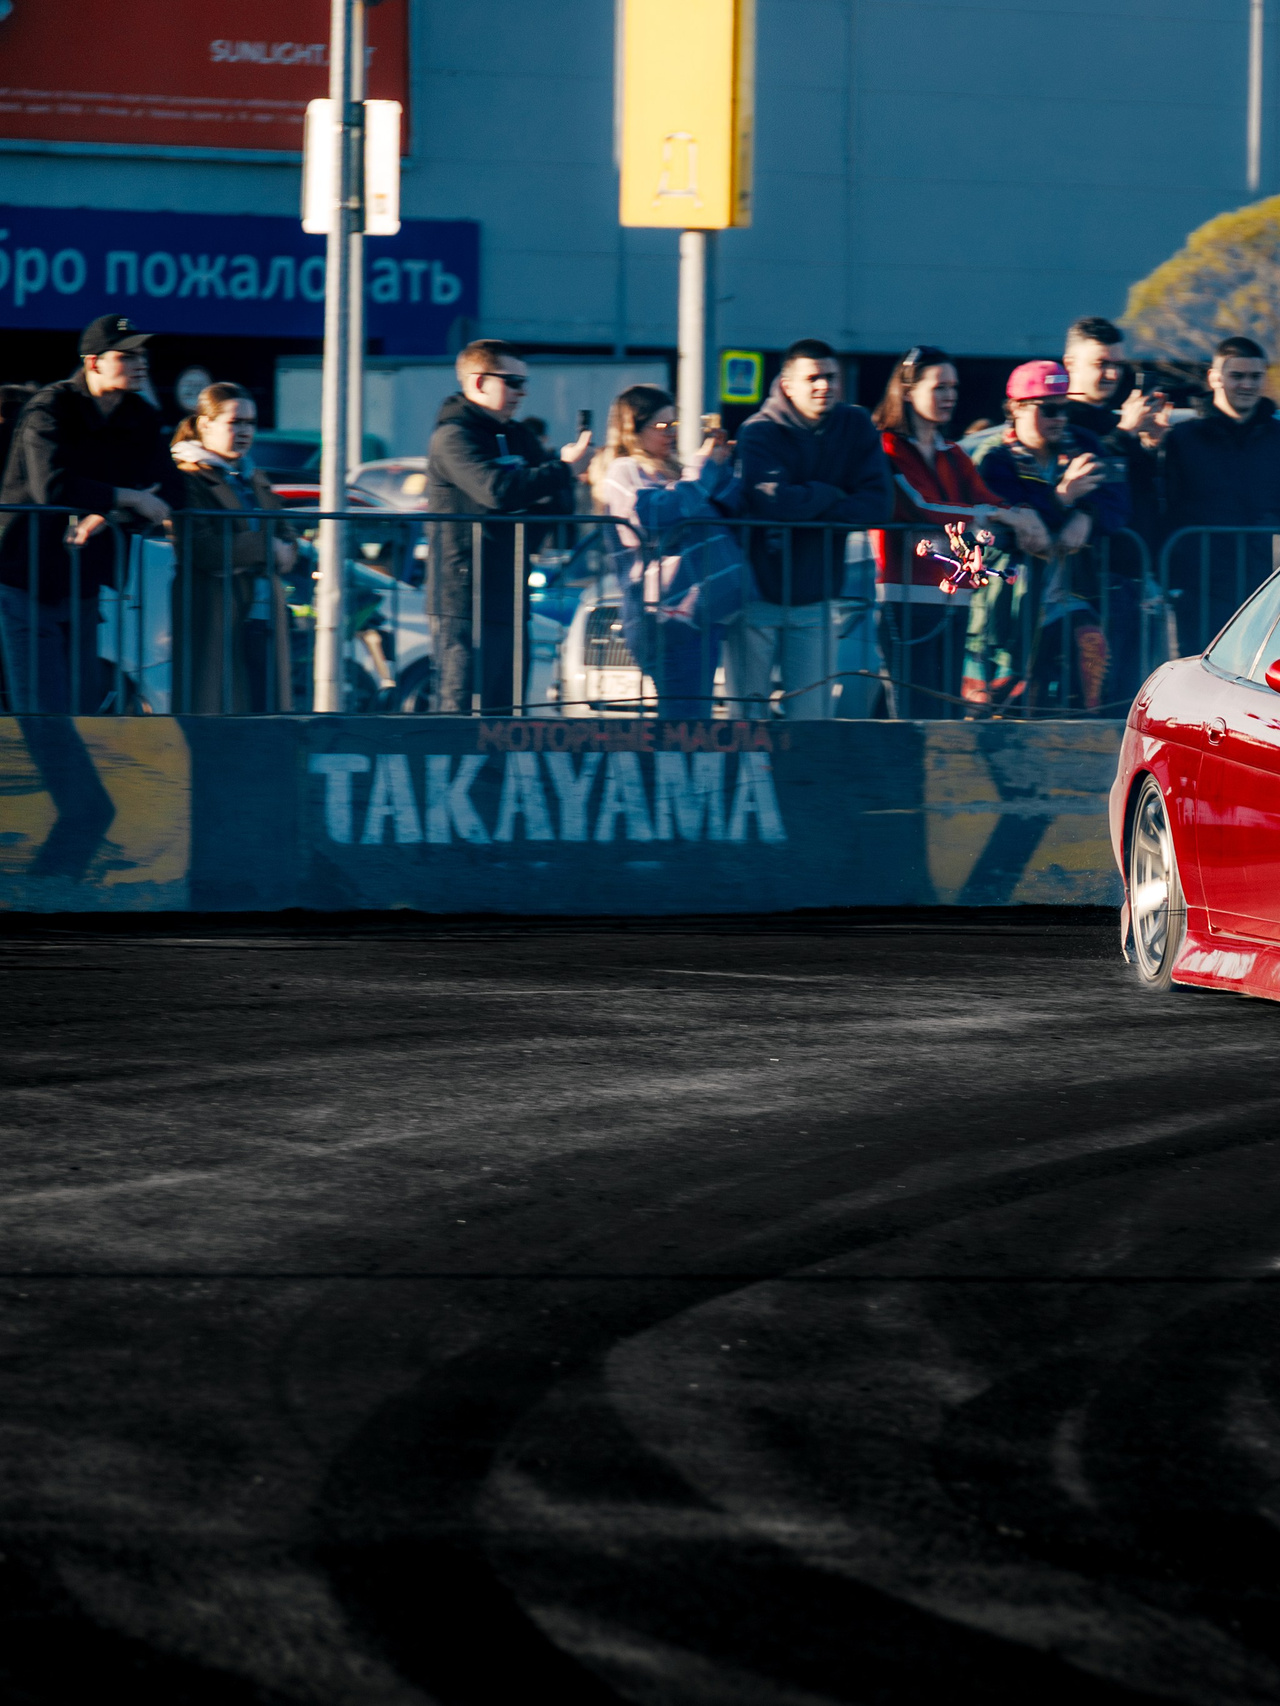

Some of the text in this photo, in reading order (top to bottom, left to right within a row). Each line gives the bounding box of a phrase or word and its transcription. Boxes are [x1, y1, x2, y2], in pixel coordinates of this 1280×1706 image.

[210, 39, 377, 67] SUNLIGHT.T
[106, 249, 463, 305] пожалоать
[308, 752, 788, 844] TAKAYAMA
